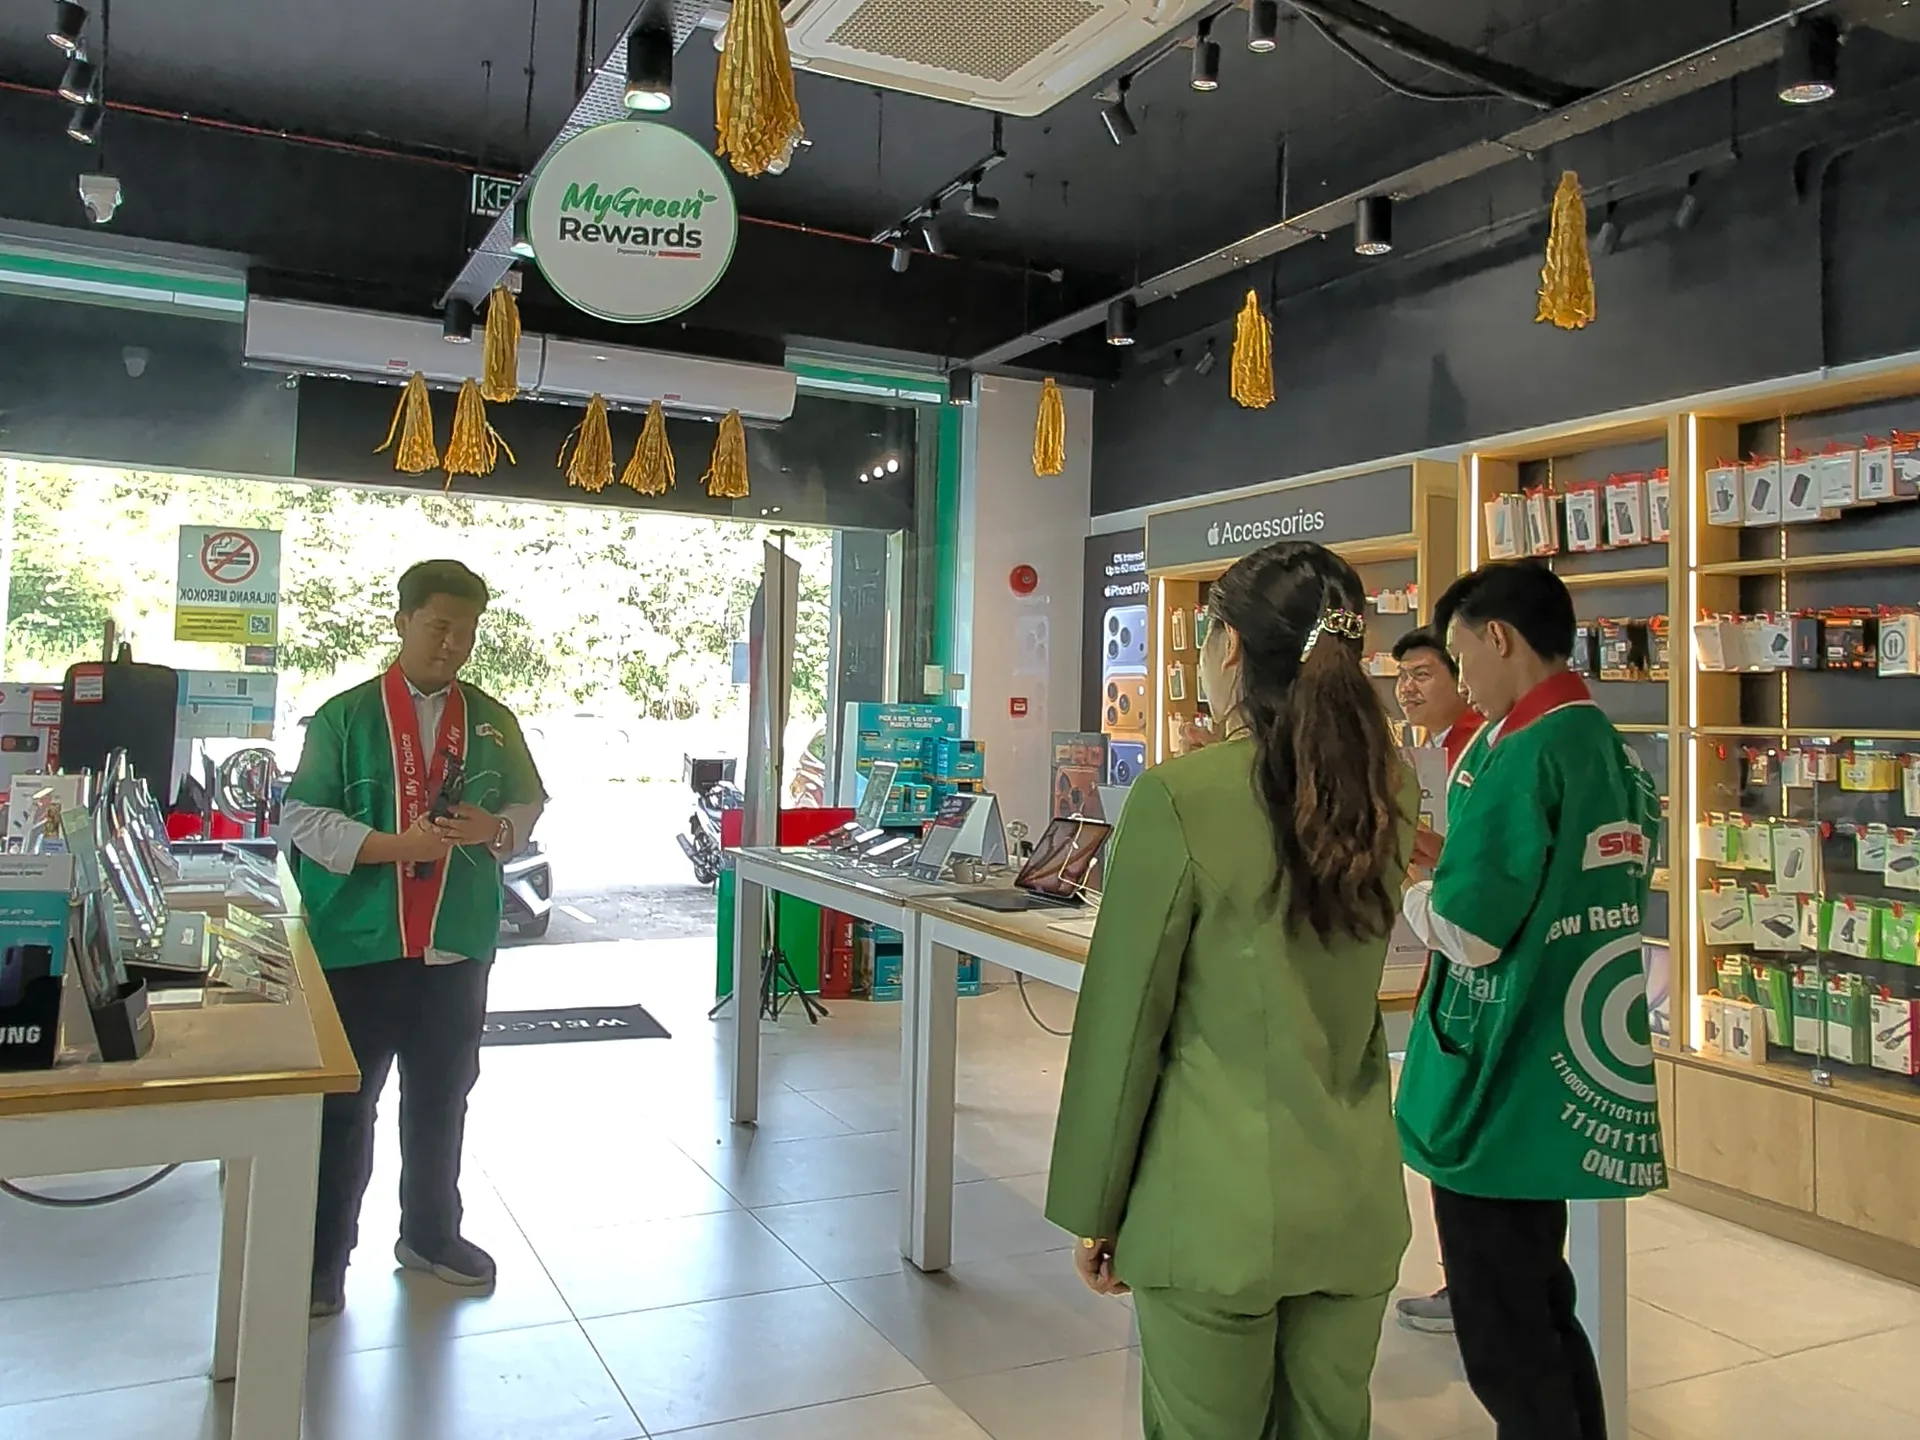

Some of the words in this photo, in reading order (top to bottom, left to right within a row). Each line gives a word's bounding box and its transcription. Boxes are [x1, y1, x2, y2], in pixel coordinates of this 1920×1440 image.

[560, 182, 702, 224] MyGreen
[559, 217, 702, 249] Rewards
[1221, 509, 1325, 545] Accessories
[401, 733, 416, 775] Choice
[406, 780, 420, 796] My
[1545, 913, 1582, 944] ew
[1581, 1149, 1664, 1186] ONLINE
